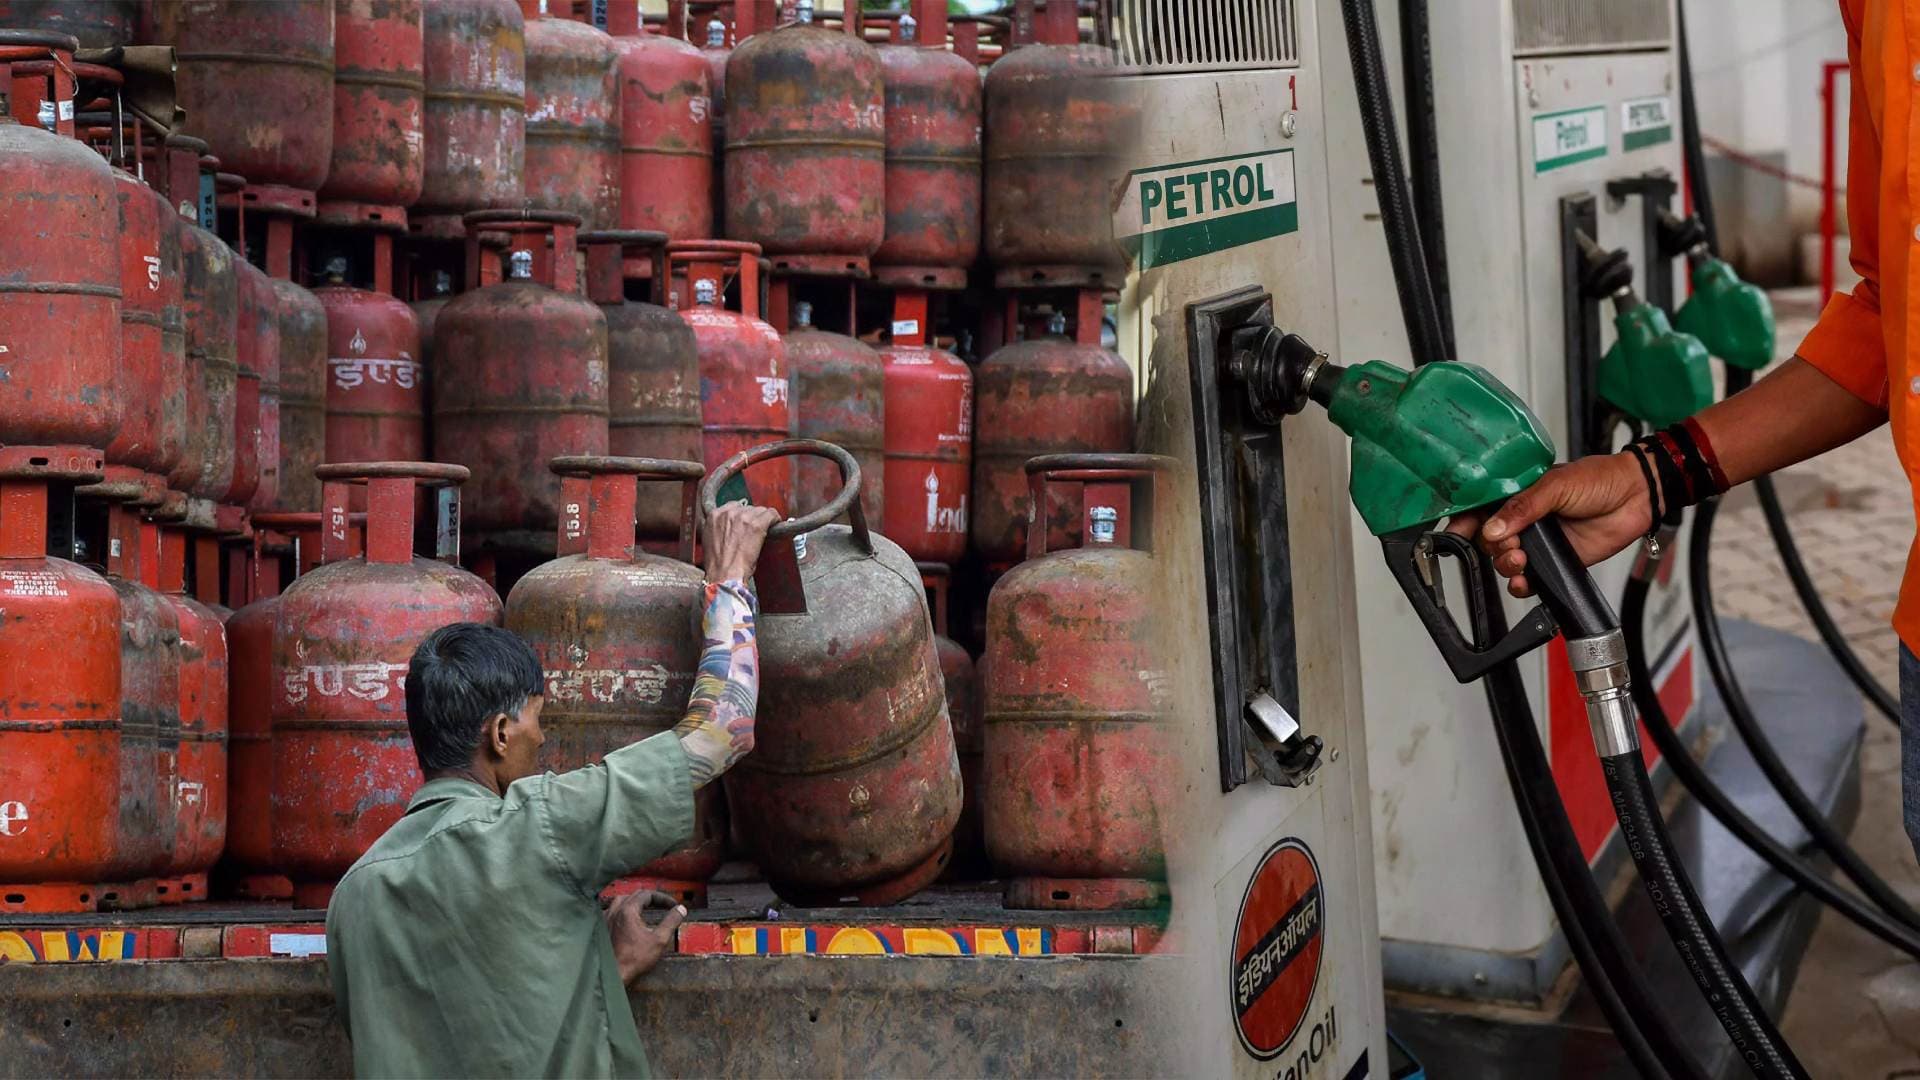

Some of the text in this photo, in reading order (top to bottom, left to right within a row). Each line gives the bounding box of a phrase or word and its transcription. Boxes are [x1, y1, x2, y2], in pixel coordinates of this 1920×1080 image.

[1140, 162, 1274, 225] PETROL
[332, 506, 345, 541] 15.7
[566, 503, 581, 540] 15.8
[1238, 897, 1317, 1006] इंडियनऑयल
